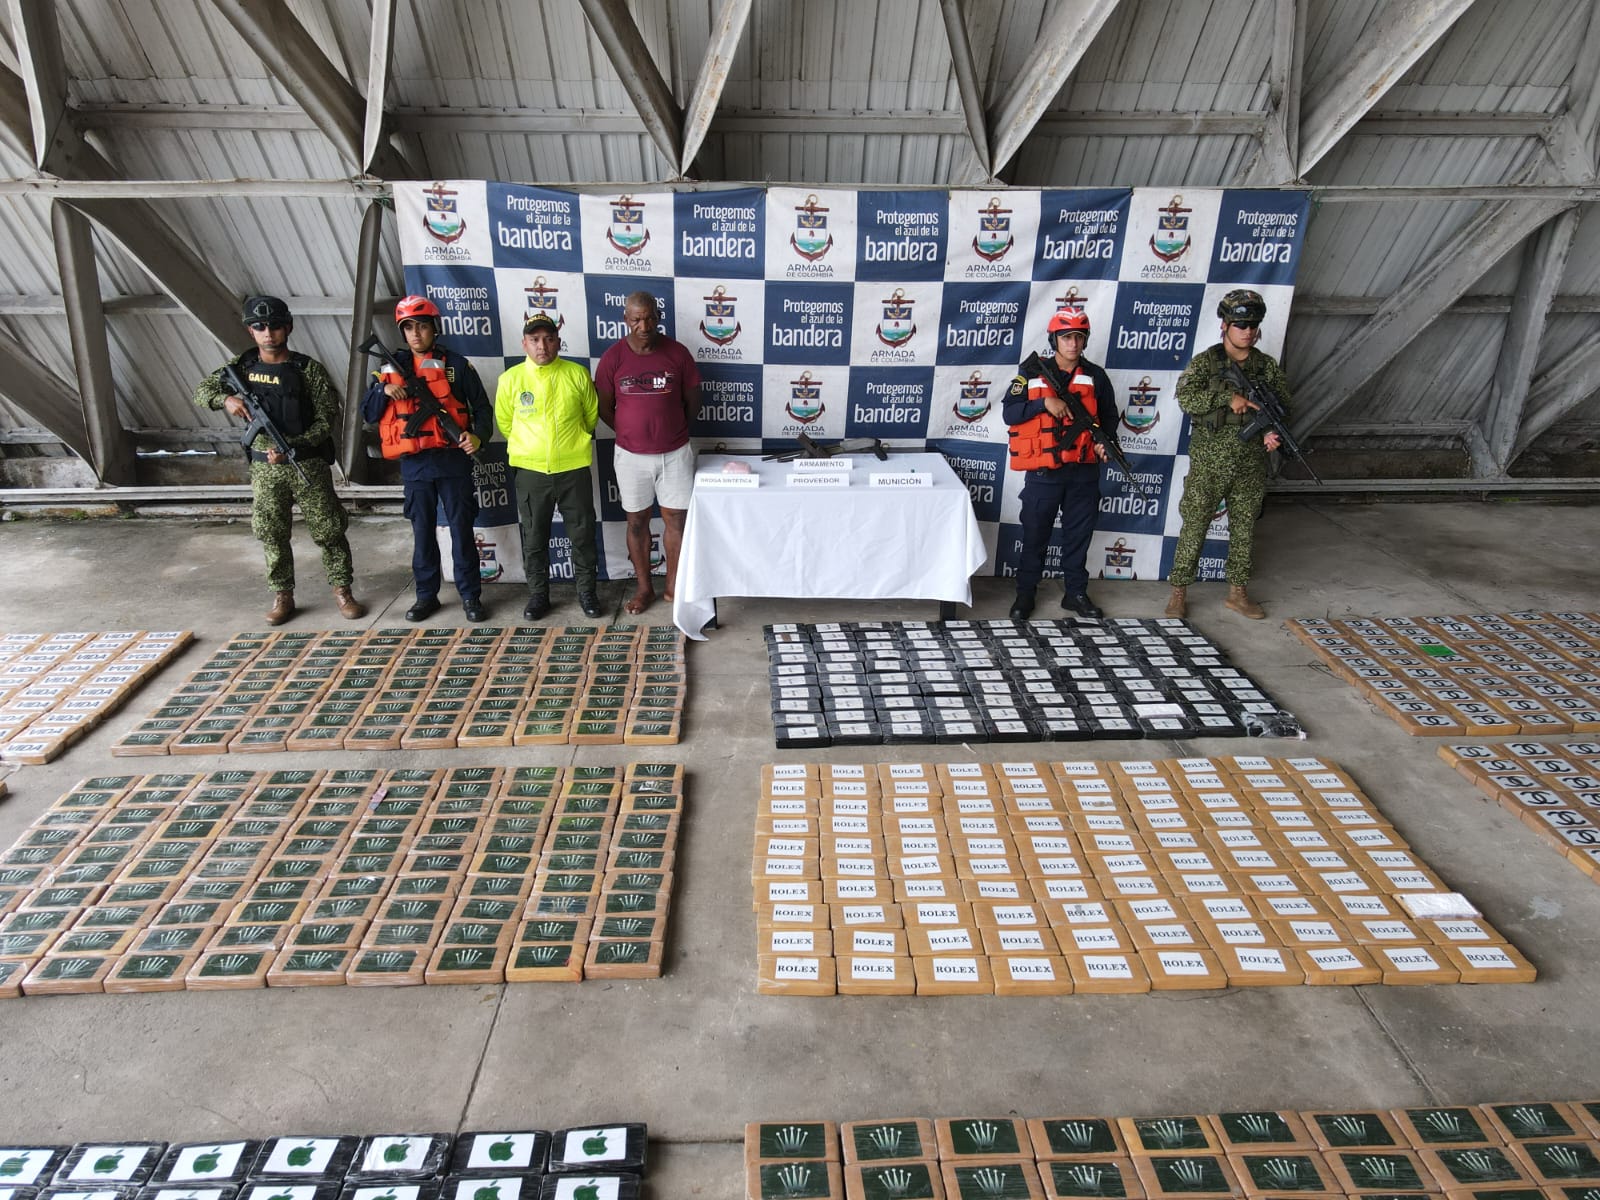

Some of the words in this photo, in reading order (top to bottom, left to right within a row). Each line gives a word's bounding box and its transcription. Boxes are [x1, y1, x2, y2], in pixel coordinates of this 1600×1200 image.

[507, 194, 570, 214] Protegemos
[693, 204, 756, 222] Protegemos
[876, 209, 939, 227] Protegemos
[1059, 209, 1119, 225] Protegemos
[526, 213, 533, 223] el
[535, 213, 550, 224] azul
[553, 214, 561, 224] de
[564, 215, 570, 225] la
[1237, 210, 1298, 227] Protegemos
[712, 221, 718, 231] el
[721, 221, 735, 231] azul
[738, 222, 746, 231] de
[749, 222, 755, 232] la
[895, 226, 901, 235] el
[904, 226, 918, 235] azul
[921, 226, 929, 235] de
[932, 226, 938, 235] la
[1075, 224, 1081, 233] el
[1083, 224, 1098, 234] azul
[1100, 224, 1108, 233] de
[1110, 224, 1116, 233] la
[498, 221, 572, 251] bandera
[1253, 227, 1259, 236] el
[1261, 227, 1275, 236] azul
[1277, 227, 1286, 237] de
[1288, 227, 1295, 237] la
[682, 231, 755, 258] bandera
[865, 235, 937, 261] bandera
[1043, 235, 1114, 260] bandera
[1220, 236, 1292, 263] bandera
[424, 246, 471, 255] ARMADA
[605, 257, 651, 266] ARMADA
[787, 263, 833, 272] ARMADA
[966, 264, 1011, 272] ARMADA
[1142, 264, 1188, 273] ARMADA
[426, 284, 488, 301] Protegemos
[447, 300, 453, 310] el
[455, 300, 470, 310] azul
[472, 301, 480, 310] de
[483, 301, 489, 310] la
[783, 299, 844, 314] Protegemos
[960, 300, 1019, 316] Protegemos
[1133, 300, 1192, 317] Protegemos
[801, 314, 807, 323] el
[809, 314, 824, 323] azul
[826, 314, 834, 323] de
[837, 315, 842, 323] la
[976, 315, 982, 324] el
[984, 315, 998, 324] azul
[1000, 315, 1009, 323] de
[1011, 314, 1016, 322] la
[1149, 318, 1155, 326] el
[1157, 318, 1171, 326] azul
[1173, 318, 1181, 326] de
[1183, 317, 1189, 326] la
[440, 312, 492, 336] ndera
[772, 323, 842, 347] bandera
[946, 324, 1014, 347] bandera
[1117, 325, 1187, 351] bandera
[697, 347, 742, 355] ARMADA
[871, 350, 915, 358] ARMADA
[249, 372, 279, 385] GAULA
[701, 381, 754, 394] rotegemos
[866, 382, 924, 396] Protegemos
[883, 395, 888, 403] el
[890, 395, 904, 403] azul
[916, 395, 922, 403] la
[697, 402, 753, 422] andera
[854, 404, 921, 423] bandera
[946, 424, 989, 433] ARMADA
[1391, 875, 1427, 884] ROLEX
[1346, 902, 1383, 910] ROLEX
[775, 909, 812, 917] ROLEX
[919, 909, 956, 917] ROLEX
[1150, 930, 1188, 939] ROLEX
[1223, 929, 1261, 938] ROLEX
[1295, 927, 1334, 936] ROLEX
[1371, 926, 1410, 935] ROLEX
[774, 936, 812, 945] ROLEX
[856, 938, 893, 946] ROLEX
[931, 935, 969, 945] ROLEX
[1002, 936, 1041, 945] ROLEX
[1077, 934, 1115, 943] ROLEX
[1163, 959, 1203, 969] ROLEX
[1240, 955, 1281, 965] ROLEX
[1316, 955, 1356, 965] ROLEX
[1391, 955, 1432, 964] ROLEX
[1466, 954, 1507, 964] ROLEX
[778, 964, 817, 973] ROLEX
[853, 964, 893, 973] ROLEX
[936, 964, 975, 974] ROLEX
[1011, 964, 1051, 974] ROLEX
[1088, 962, 1128, 971] ROLEX
